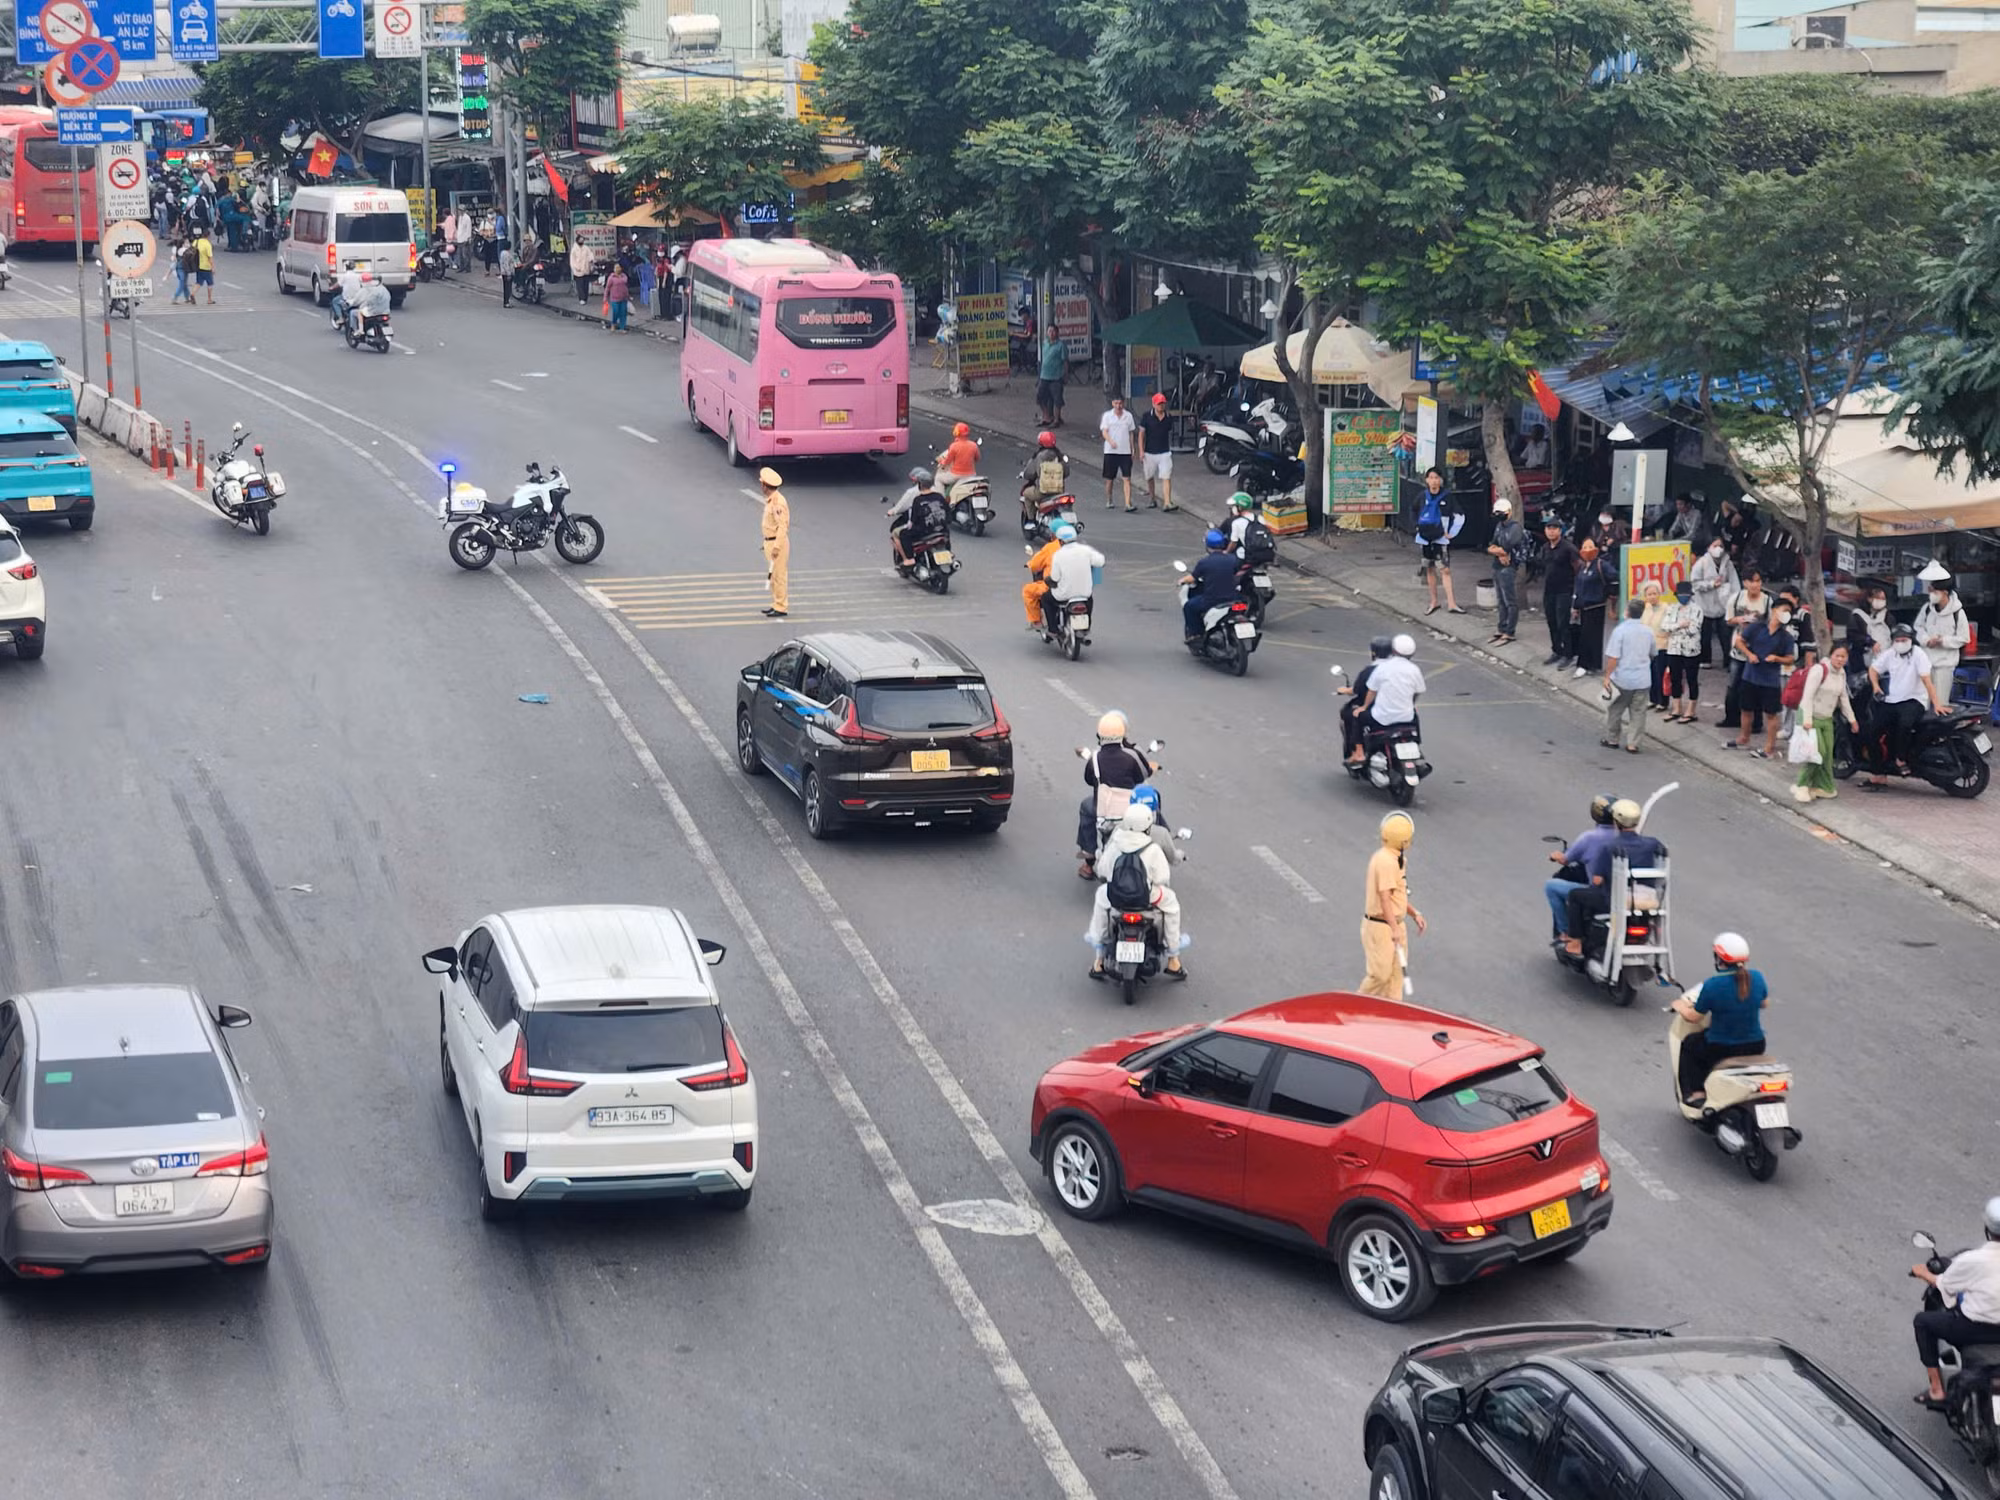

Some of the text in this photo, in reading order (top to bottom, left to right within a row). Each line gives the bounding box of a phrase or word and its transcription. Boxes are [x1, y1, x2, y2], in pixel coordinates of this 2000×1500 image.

[113, 12, 152, 24] NÚT GIAO
[118, 26, 131, 37] AN
[122, 40, 146, 50] 15 km
[82, 123, 93, 131] XE
[62, 133, 73, 142] AN
[111, 144, 133, 155] ZONE
[353, 201, 390, 212] SƠN CA
[972, 297, 991, 310] NHÀ
[994, 296, 1005, 308] XE
[986, 311, 1006, 321] LONG
[1859, 560, 1892, 568] 24/24
[1631, 547, 1685, 597] PHỞ
[160, 1152, 199, 1168] TẬP LÁI
[131, 1184, 157, 1199] 51L
